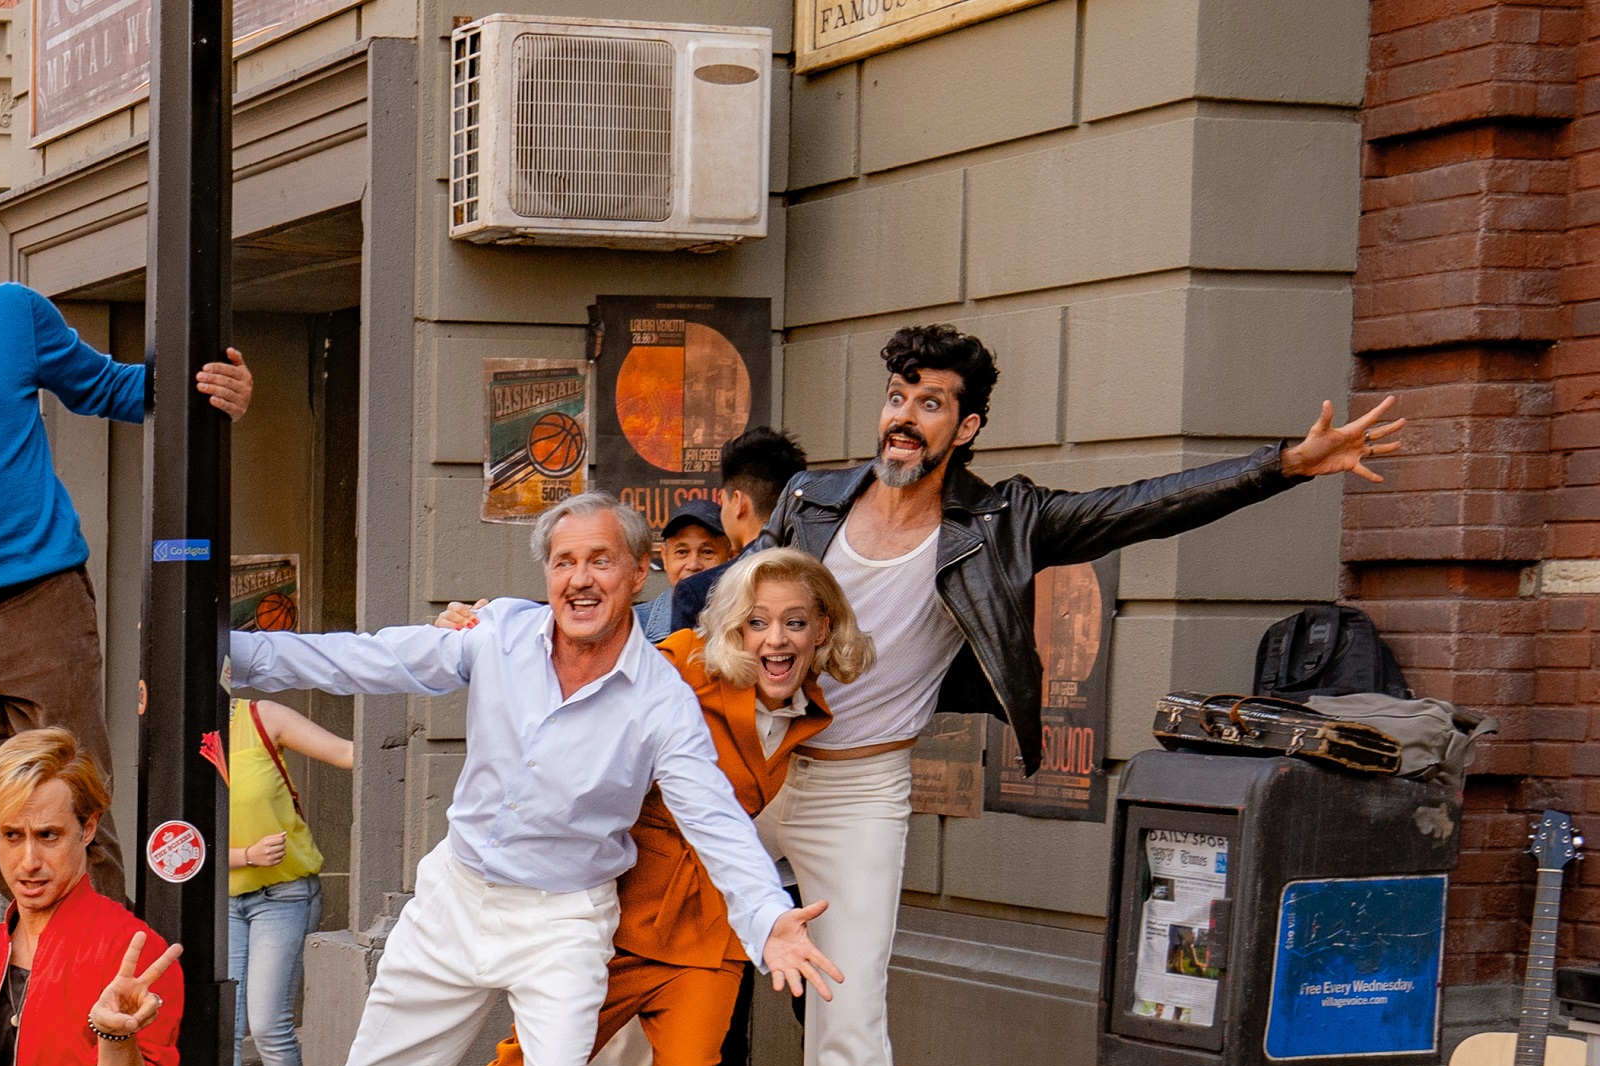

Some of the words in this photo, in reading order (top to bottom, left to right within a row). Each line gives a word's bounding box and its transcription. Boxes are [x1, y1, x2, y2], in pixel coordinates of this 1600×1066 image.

[47, 29, 112, 93] METAL
[493, 379, 583, 418] BASKETBALL
[230, 567, 295, 598] BASKETBALL
[1149, 829, 1189, 844] DAILY
[1300, 982, 1321, 995] Free
[1323, 981, 1351, 995] Every
[1321, 996, 1388, 1008] villagevoice.com
